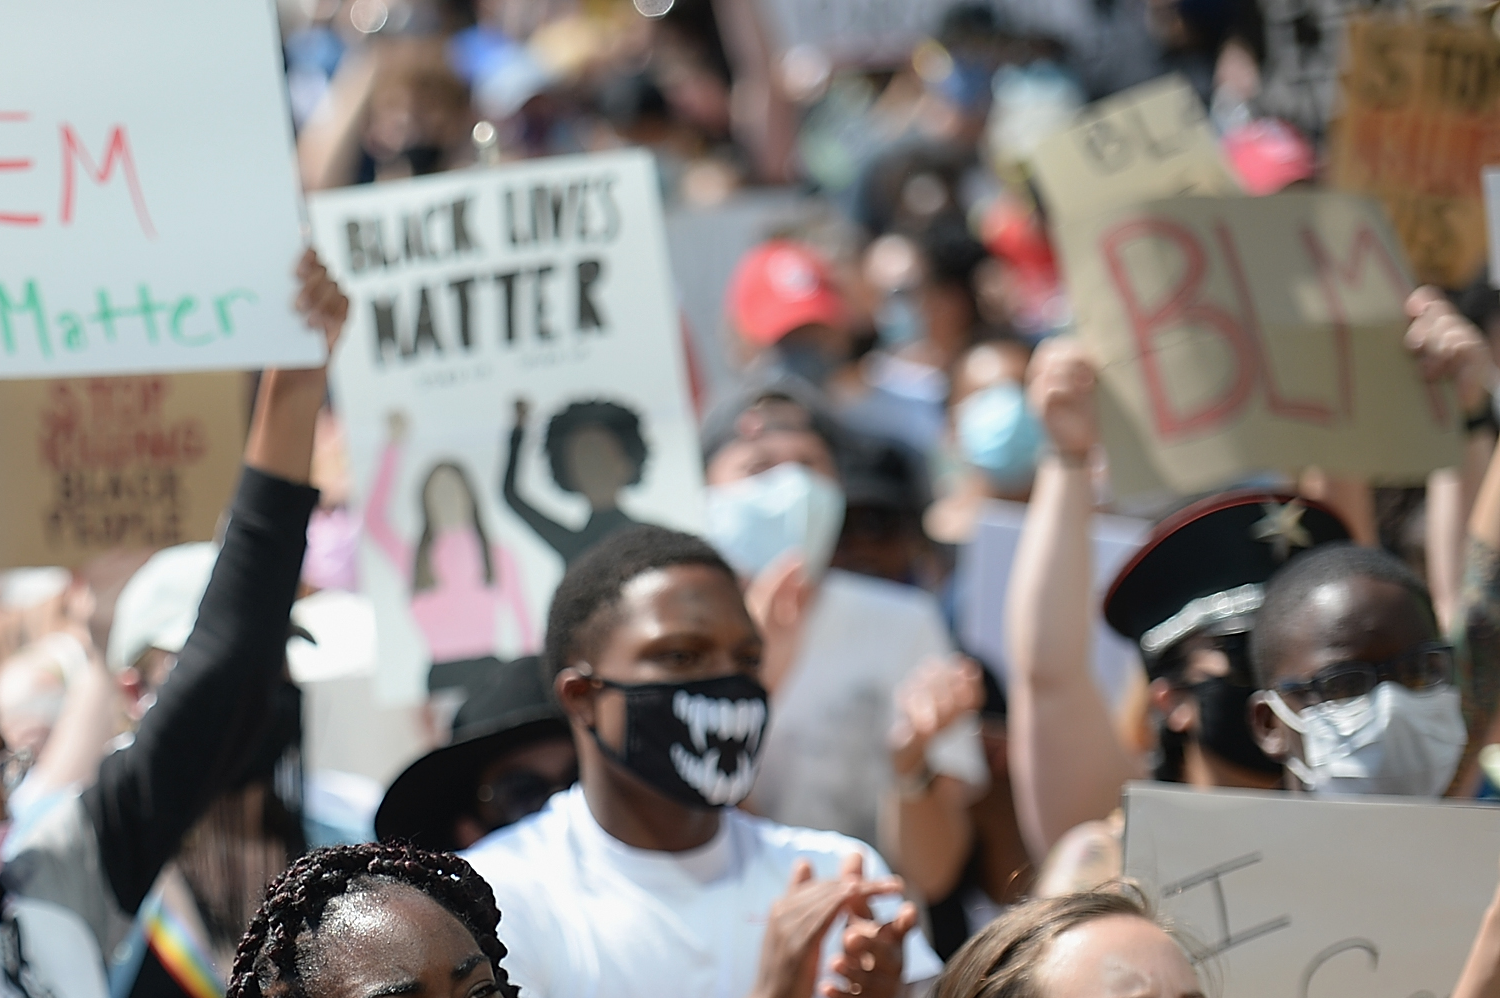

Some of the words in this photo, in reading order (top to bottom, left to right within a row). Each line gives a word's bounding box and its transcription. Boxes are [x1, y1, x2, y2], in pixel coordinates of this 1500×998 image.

[345, 195, 490, 278] BLACK
[503, 176, 622, 246] LIVES
[370, 258, 610, 370] MATTER
[1100, 208, 1455, 440] BLM
